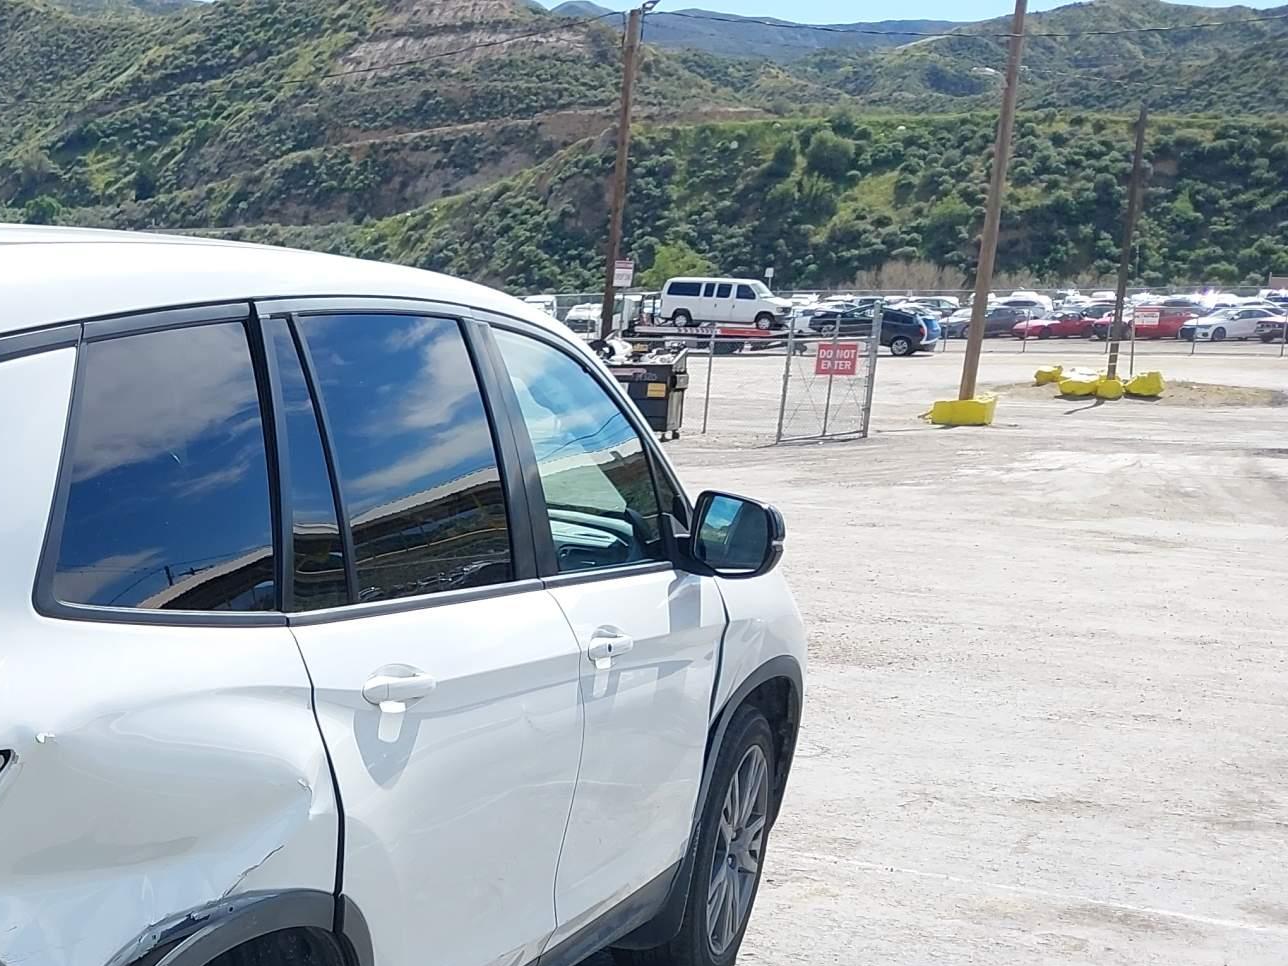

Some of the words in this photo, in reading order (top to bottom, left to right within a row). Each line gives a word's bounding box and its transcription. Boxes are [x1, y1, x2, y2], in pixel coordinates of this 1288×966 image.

[819, 349, 833, 359] DO
[835, 349, 856, 359] NOT
[820, 360, 852, 370] ENTER
